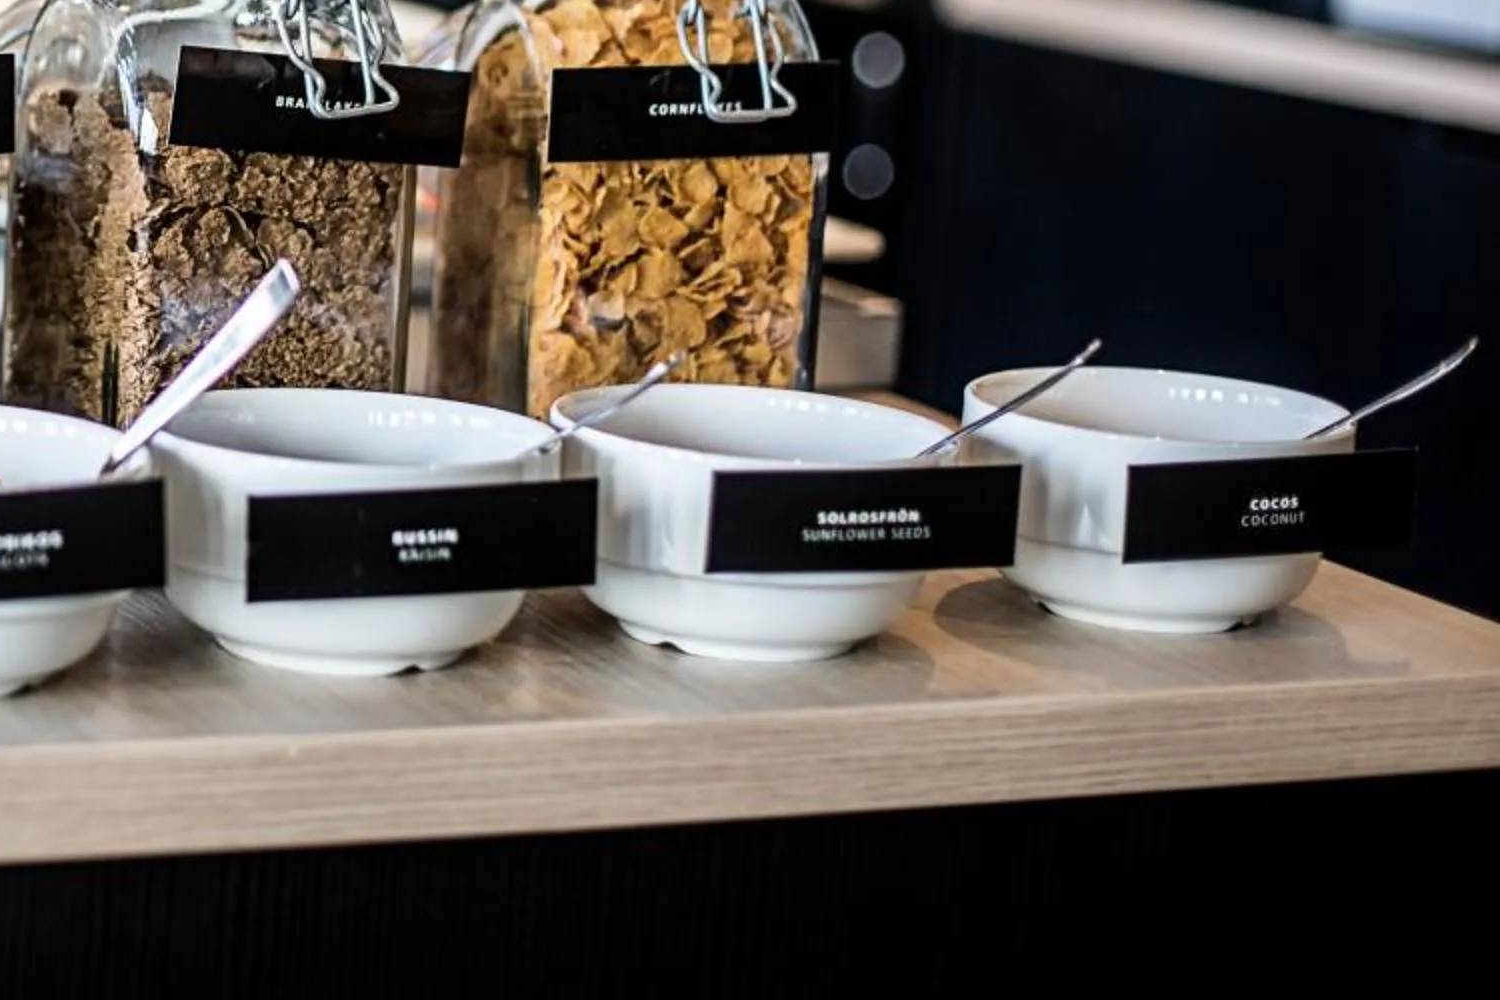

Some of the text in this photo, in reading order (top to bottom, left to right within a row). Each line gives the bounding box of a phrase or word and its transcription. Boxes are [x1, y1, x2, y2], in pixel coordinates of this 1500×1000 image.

[276, 95, 367, 114] BRALAK
[648, 101, 743, 116] CORNFLKES
[1250, 496, 1299, 511] COCOS
[1241, 511, 1305, 527] COCONUT
[802, 524, 931, 542] SUNFLOWER SEEDS
